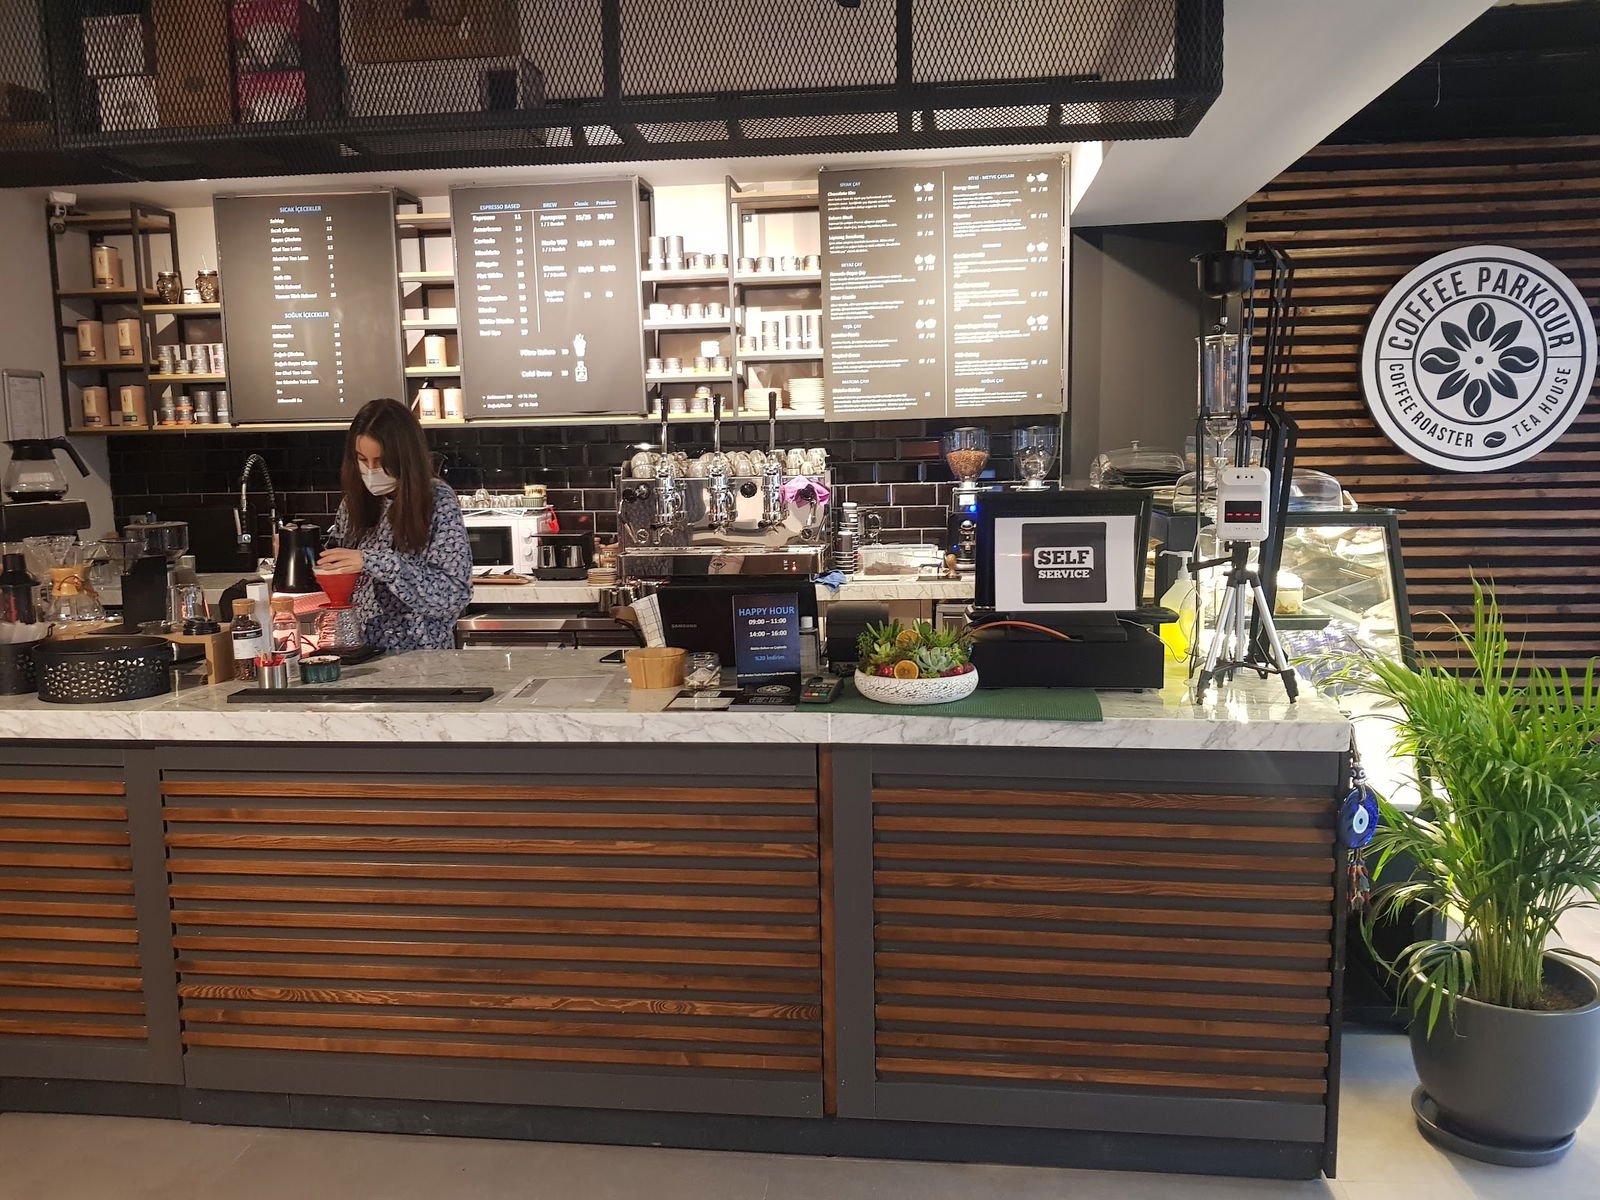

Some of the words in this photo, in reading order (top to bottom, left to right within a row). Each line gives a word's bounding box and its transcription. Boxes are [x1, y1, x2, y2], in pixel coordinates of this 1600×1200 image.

[303, 311, 329, 319] İÇECEKLER
[1388, 270, 1467, 351] COFFEE
[1477, 266, 1575, 349] PARKOUR
[1389, 363, 1416, 415] COFFEE
[1411, 410, 1474, 447] ROASTER
[1511, 416, 1541, 437] TEA
[1538, 366, 1571, 414] HOUSE
[1037, 550, 1090, 565] SELF
[1038, 569, 1091, 579] SERVICE
[738, 608, 767, 616] HAPPY
[769, 606, 795, 615] HOUR
